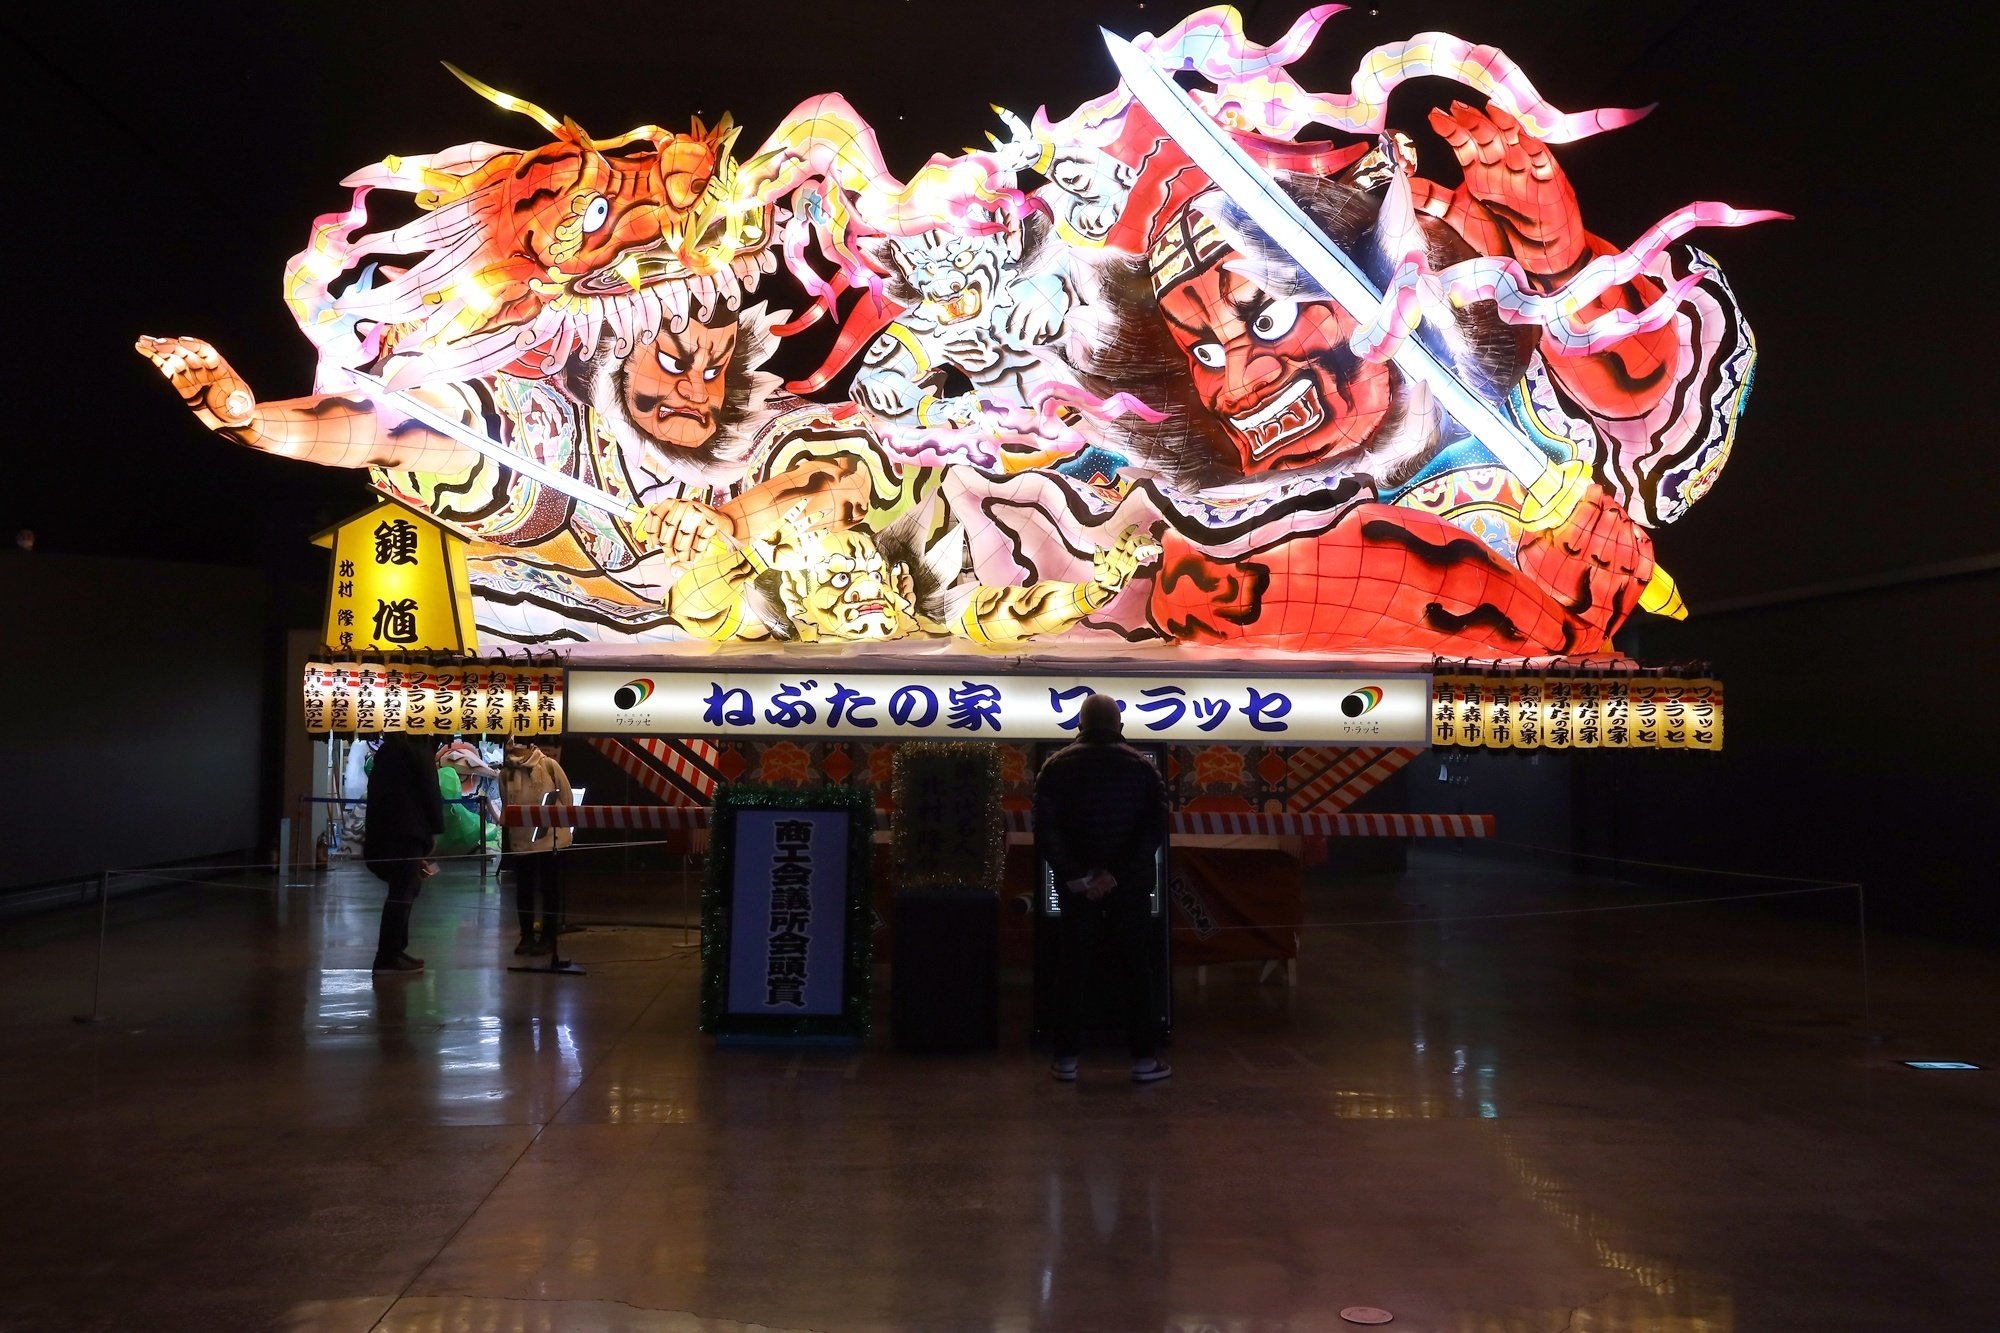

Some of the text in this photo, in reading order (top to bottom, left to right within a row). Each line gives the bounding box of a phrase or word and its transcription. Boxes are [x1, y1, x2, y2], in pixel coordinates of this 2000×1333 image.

[460, 671, 479, 730] ねぶたの家
[485, 670, 507, 730] ねぶたの家
[512, 674, 532, 732] 青森市
[537, 674, 557, 732] 青森市
[704, 683, 1002, 732] ねぶたの家
[1435, 682, 1456, 741] 青森市
[1462, 683, 1483, 742] 青森市
[1490, 684, 1512, 743] 青森市
[764, 819, 814, 1007] 商工会議所会頭賞
